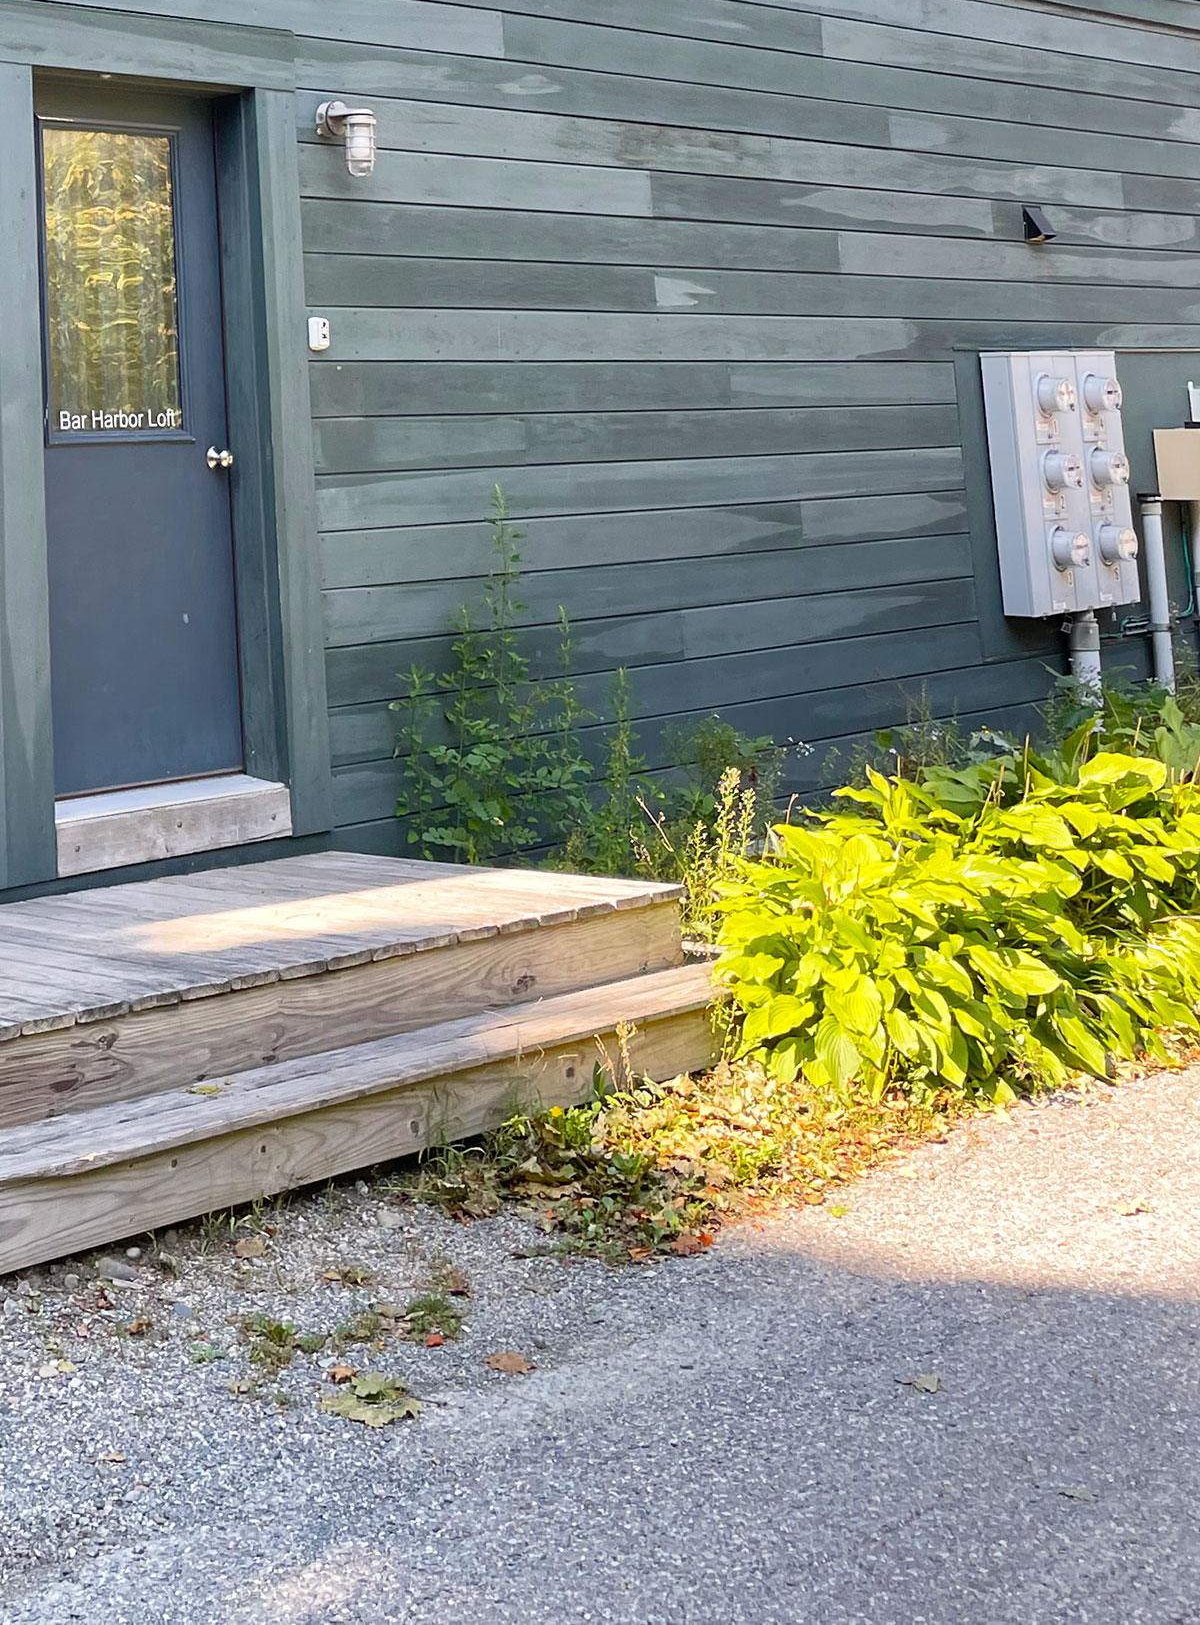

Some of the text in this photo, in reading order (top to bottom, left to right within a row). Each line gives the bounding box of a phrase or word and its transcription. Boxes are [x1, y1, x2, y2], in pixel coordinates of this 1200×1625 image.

[60, 408, 176, 430] Bar Harbor Loft
